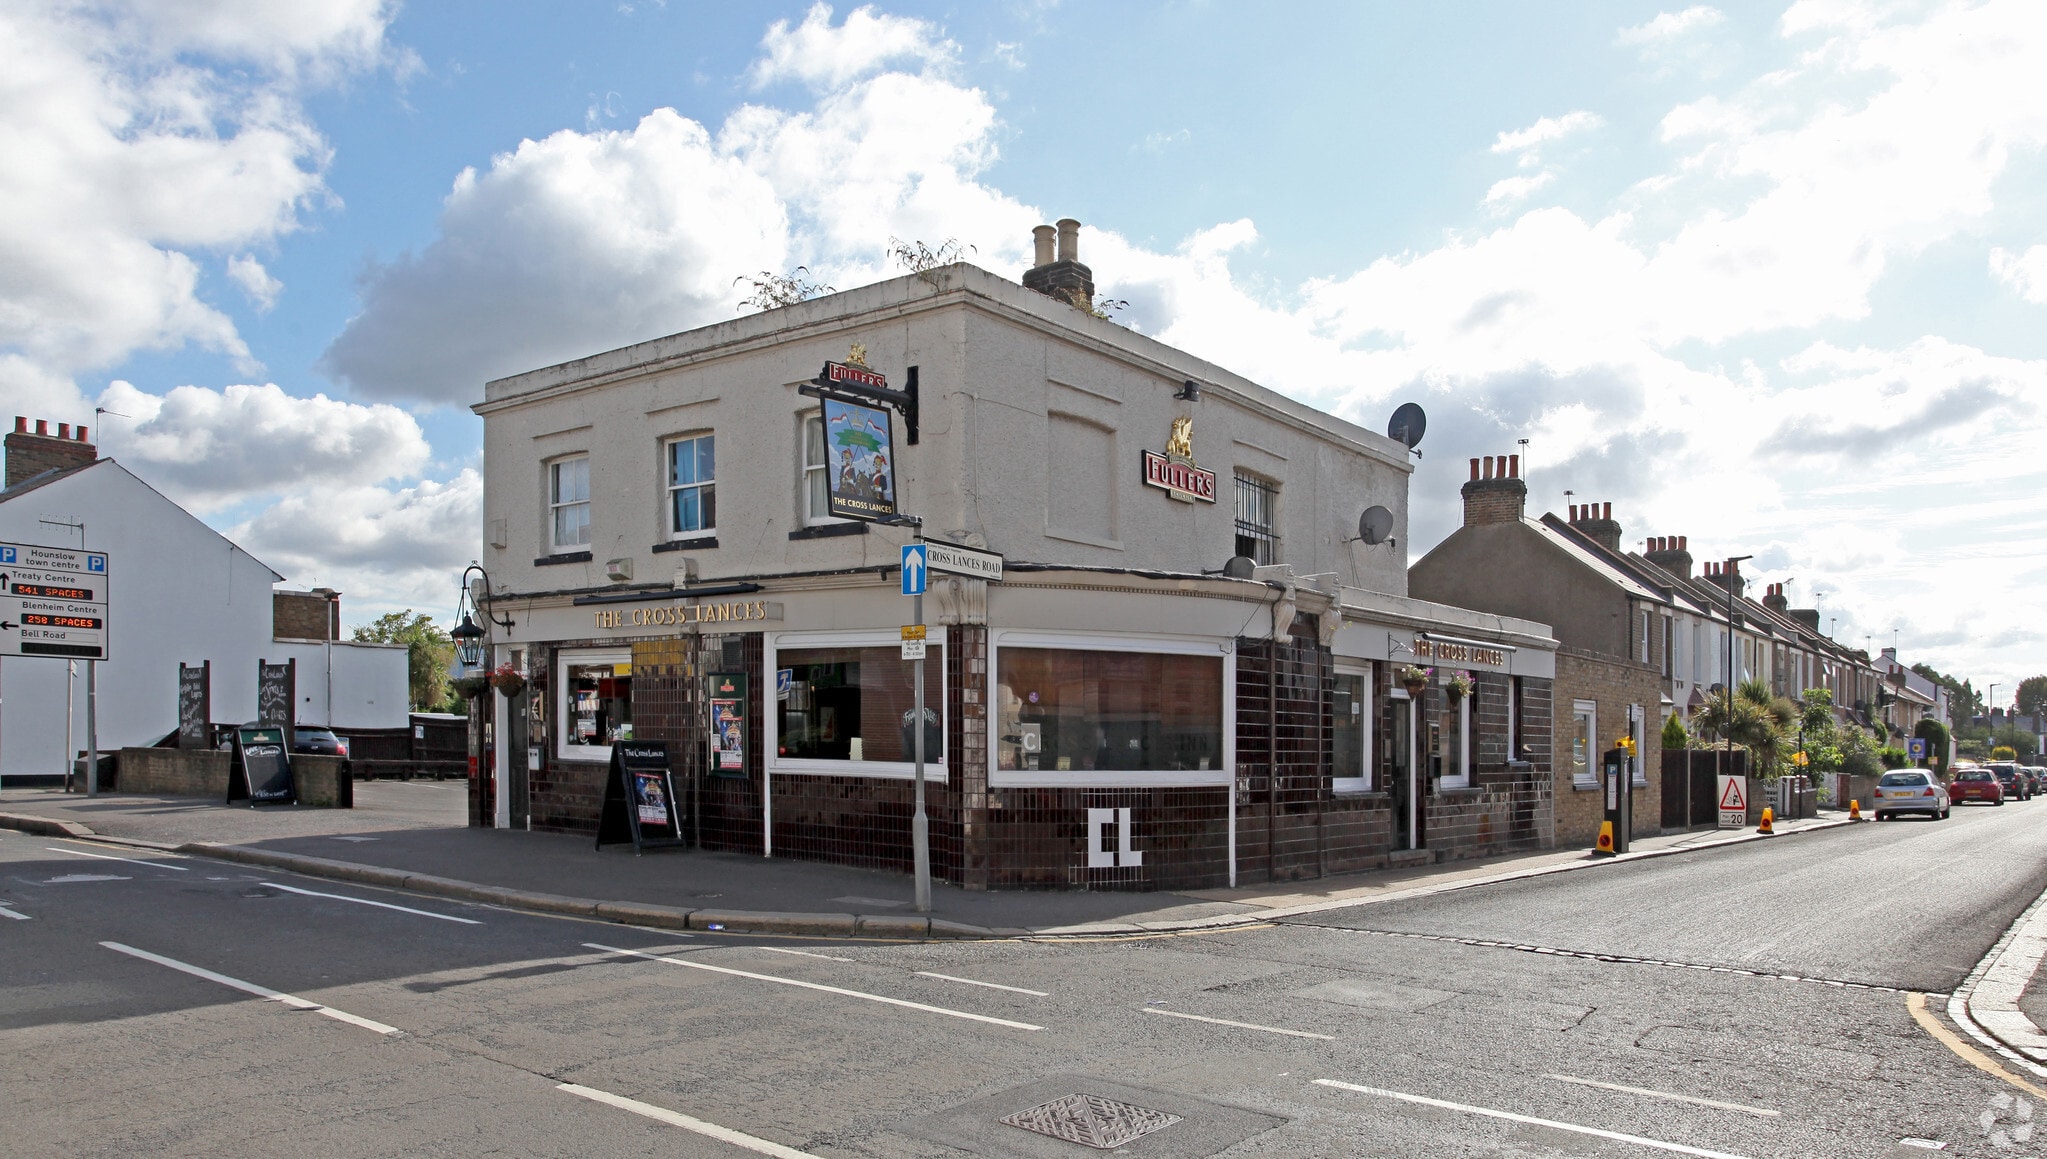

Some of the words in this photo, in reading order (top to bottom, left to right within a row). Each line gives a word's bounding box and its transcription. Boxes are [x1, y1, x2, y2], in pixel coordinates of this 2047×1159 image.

[1152, 457, 1212, 496] FULLER'S
[834, 496, 847, 507] THE
[847, 499, 868, 510] CROSS
[869, 501, 893, 514] LANCES
[2, 548, 14, 562] P
[31, 549, 76, 560] Hounslow
[26, 558, 49, 567] town
[51, 560, 81, 570] centre
[91, 557, 102, 570] P
[927, 549, 951, 564] CROSS
[953, 554, 980, 570] LANCES
[982, 560, 1001, 574] ROAD
[12, 570, 42, 582] Treaty
[44, 573, 76, 583] Centre
[18, 585, 39, 595] 541
[45, 588, 85, 598] SPACES
[22, 601, 65, 611] Blenheim
[67, 604, 98, 614] Centre
[594, 610, 623, 628] THE
[631, 606, 687, 626] CROSS
[695, 600, 767, 623] LANCES
[54, 617, 94, 628] SPACES
[21, 629, 40, 638] Bell
[43, 630, 66, 639] Road
[1414, 639, 1433, 657] THE
[1437, 642, 1468, 661] CROSS
[1471, 647, 1504, 665] LANCES
[624, 748, 635, 757] The
[1731, 814, 1743, 824] 20
